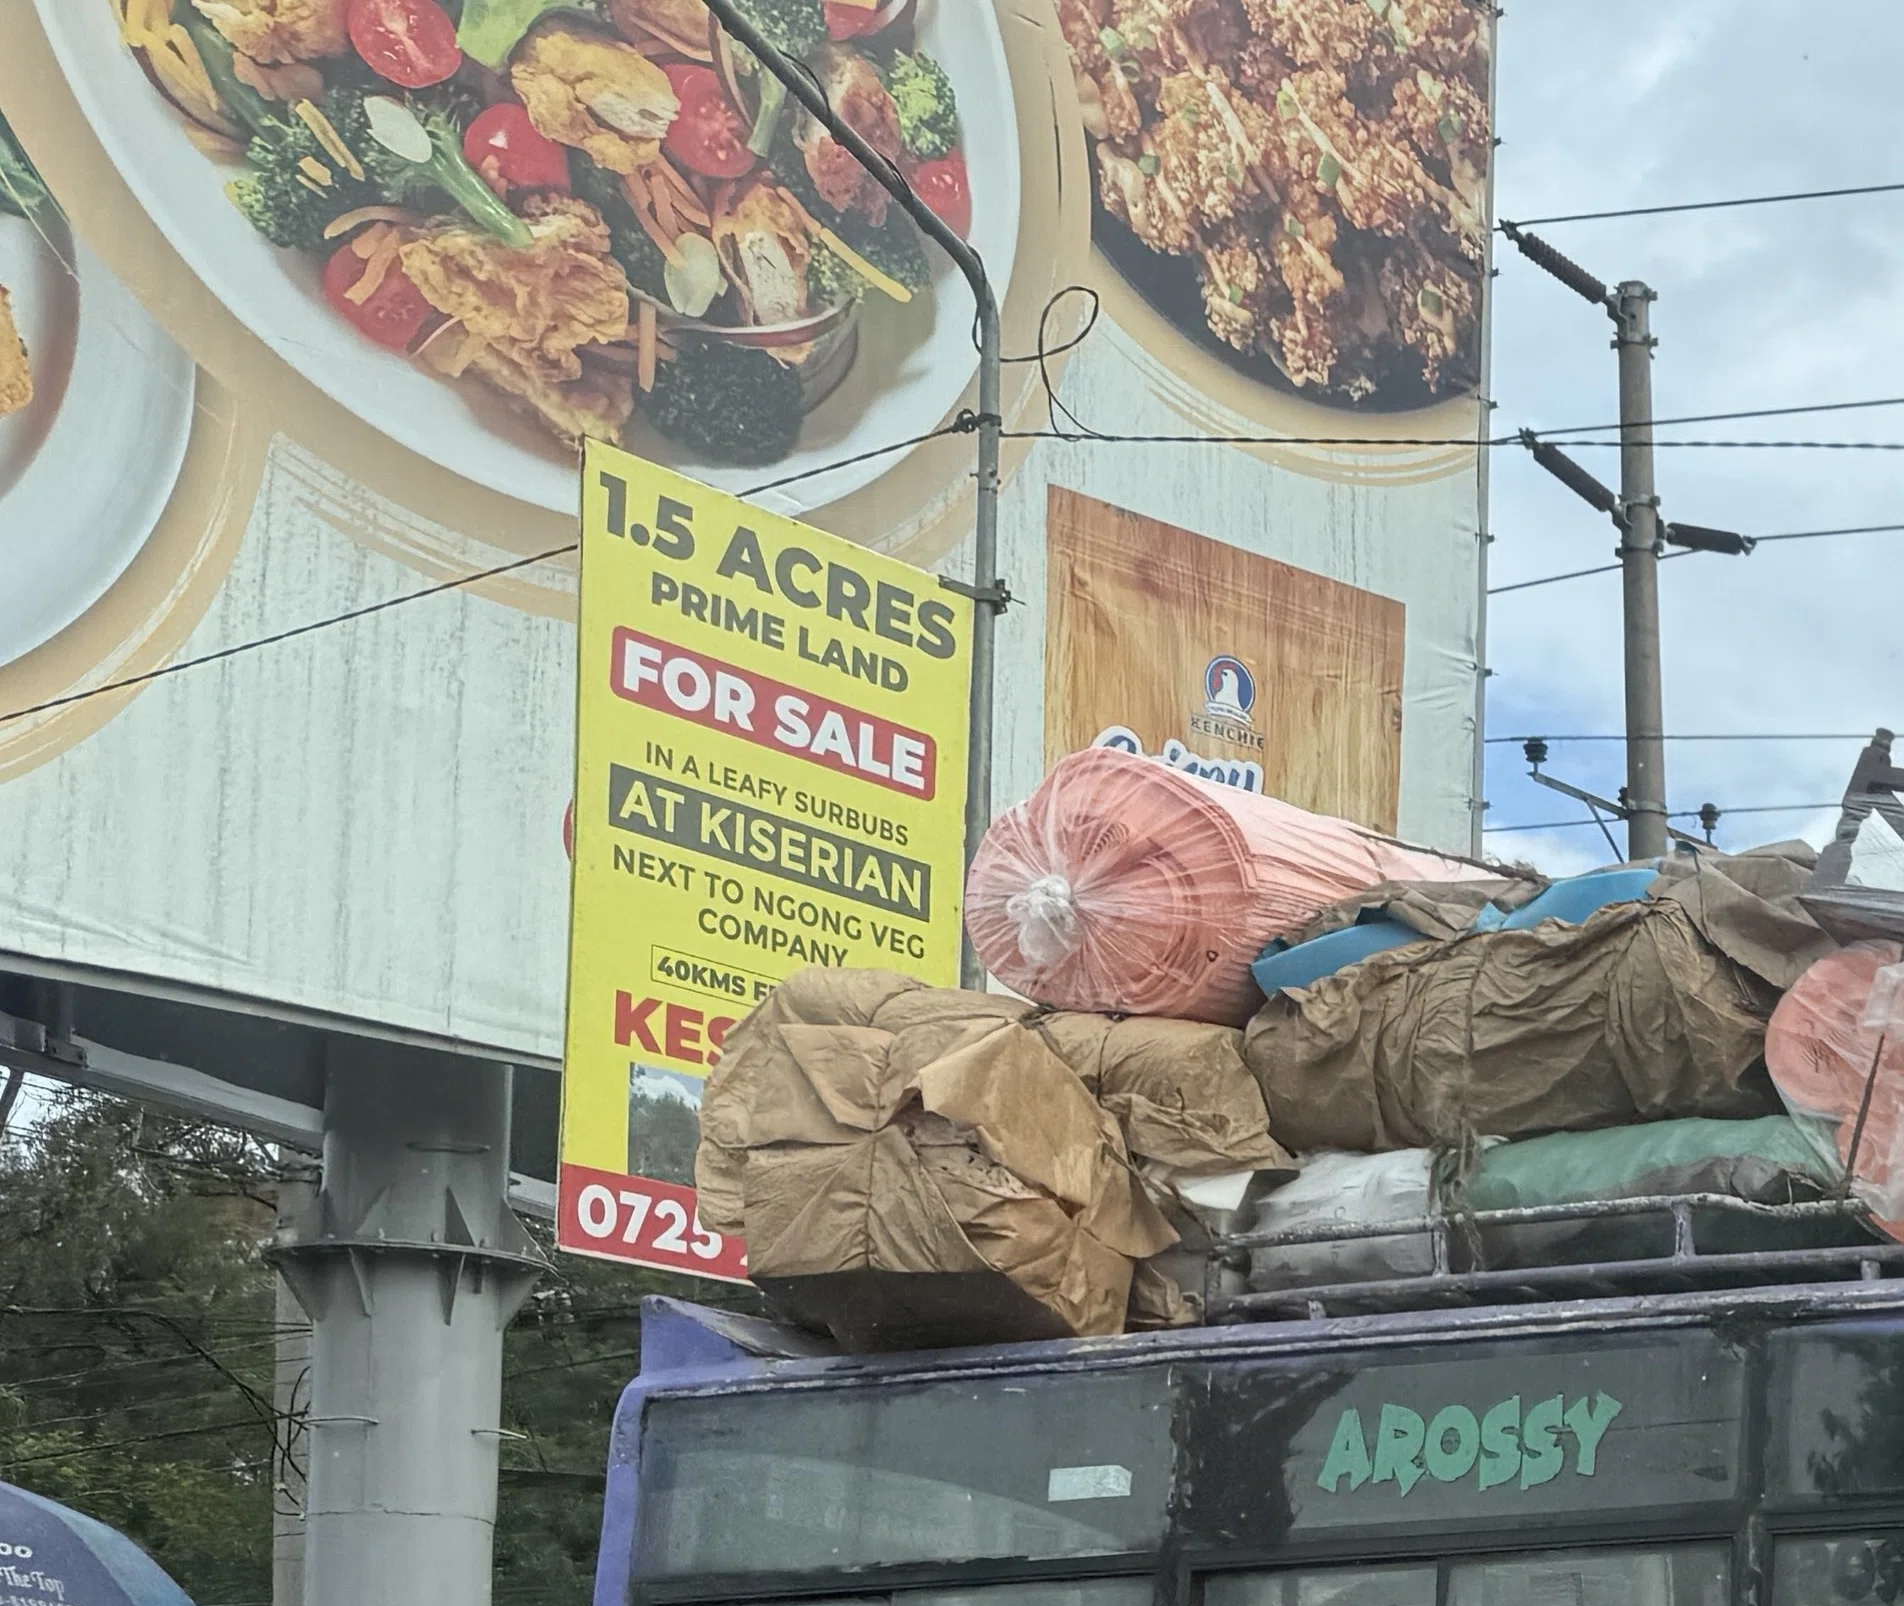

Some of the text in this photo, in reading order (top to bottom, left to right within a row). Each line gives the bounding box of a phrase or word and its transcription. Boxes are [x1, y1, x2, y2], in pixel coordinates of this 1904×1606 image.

[600, 471, 956, 659] 1.5 ACRES
[651, 571, 909, 692] PRIME LAND
[624, 638, 925, 790] FOR SALE
[619, 780, 921, 911] AT KISERIAN
[646, 741, 908, 846] IN A LEAFY SURBUBS
[613, 845, 924, 959] NEXT TO NGONG VEG
[698, 908, 848, 967] COMPANY
[657, 956, 746, 996] 40KMS
[578, 1184, 723, 1260] 0725
[1317, 1391, 1623, 1498] AROSSY
